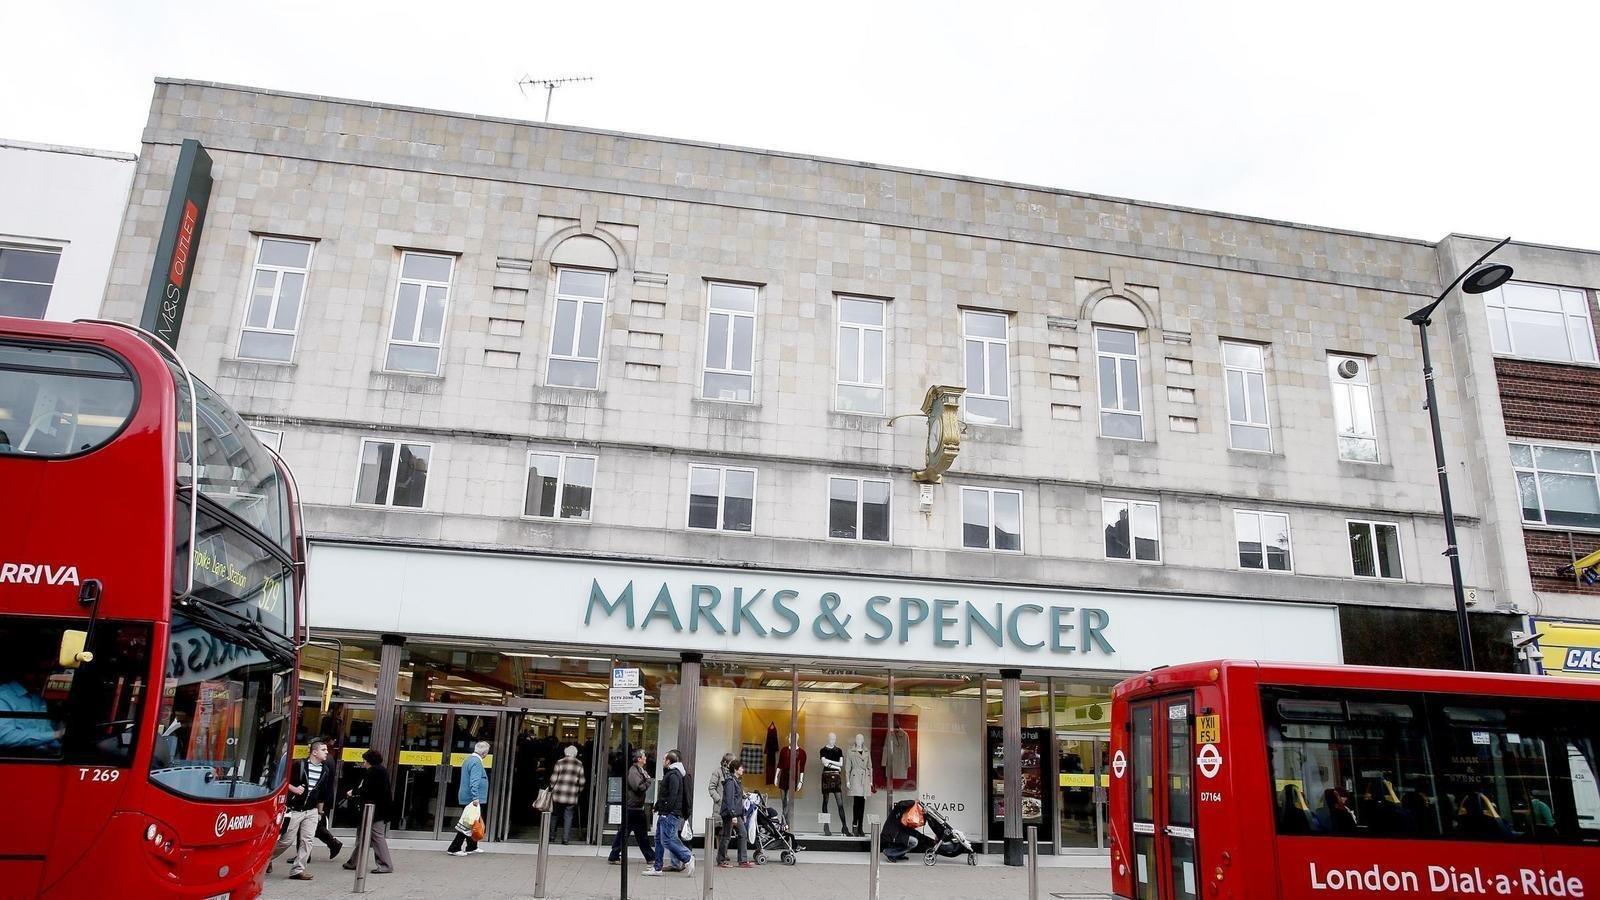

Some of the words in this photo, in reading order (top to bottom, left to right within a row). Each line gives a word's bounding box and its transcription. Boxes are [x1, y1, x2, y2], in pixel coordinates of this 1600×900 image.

[158, 283, 181, 341] M&S
[174, 210, 195, 276] OUTLET
[0, 563, 80, 587] RRIVA
[226, 563, 248, 588] Station
[258, 576, 280, 612] 329
[582, 576, 801, 637] MARKS
[811, 591, 853, 643] &
[864, 594, 1117, 655] SPENCER
[1200, 731, 1216, 743] FSJ
[79, 768, 89, 781] T
[92, 769, 120, 782] 269
[1200, 792, 1222, 802] D7164
[226, 814, 254, 831] ARRIVA
[1309, 862, 1419, 892] London
